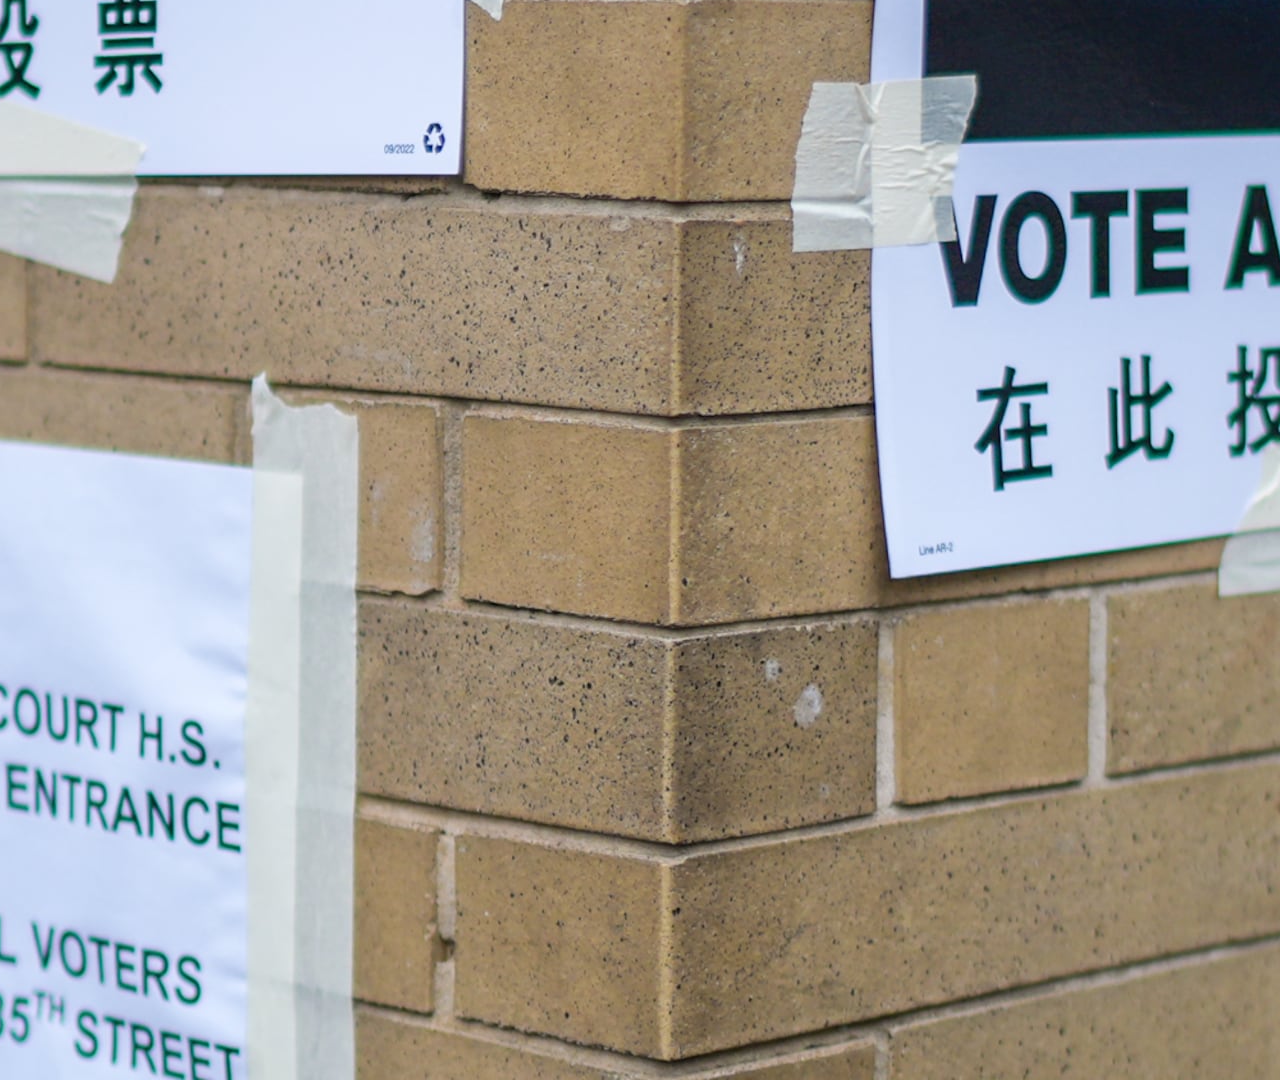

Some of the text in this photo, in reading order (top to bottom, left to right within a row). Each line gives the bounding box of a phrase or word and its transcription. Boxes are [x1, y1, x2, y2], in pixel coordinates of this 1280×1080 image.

[932, 186, 1191, 308] VOTE
[138, 711, 224, 770] H.S.
[4, 762, 244, 854] ENTRANCE
[31, 922, 204, 1006] VOTERS
[74, 1008, 241, 1080] STREET
